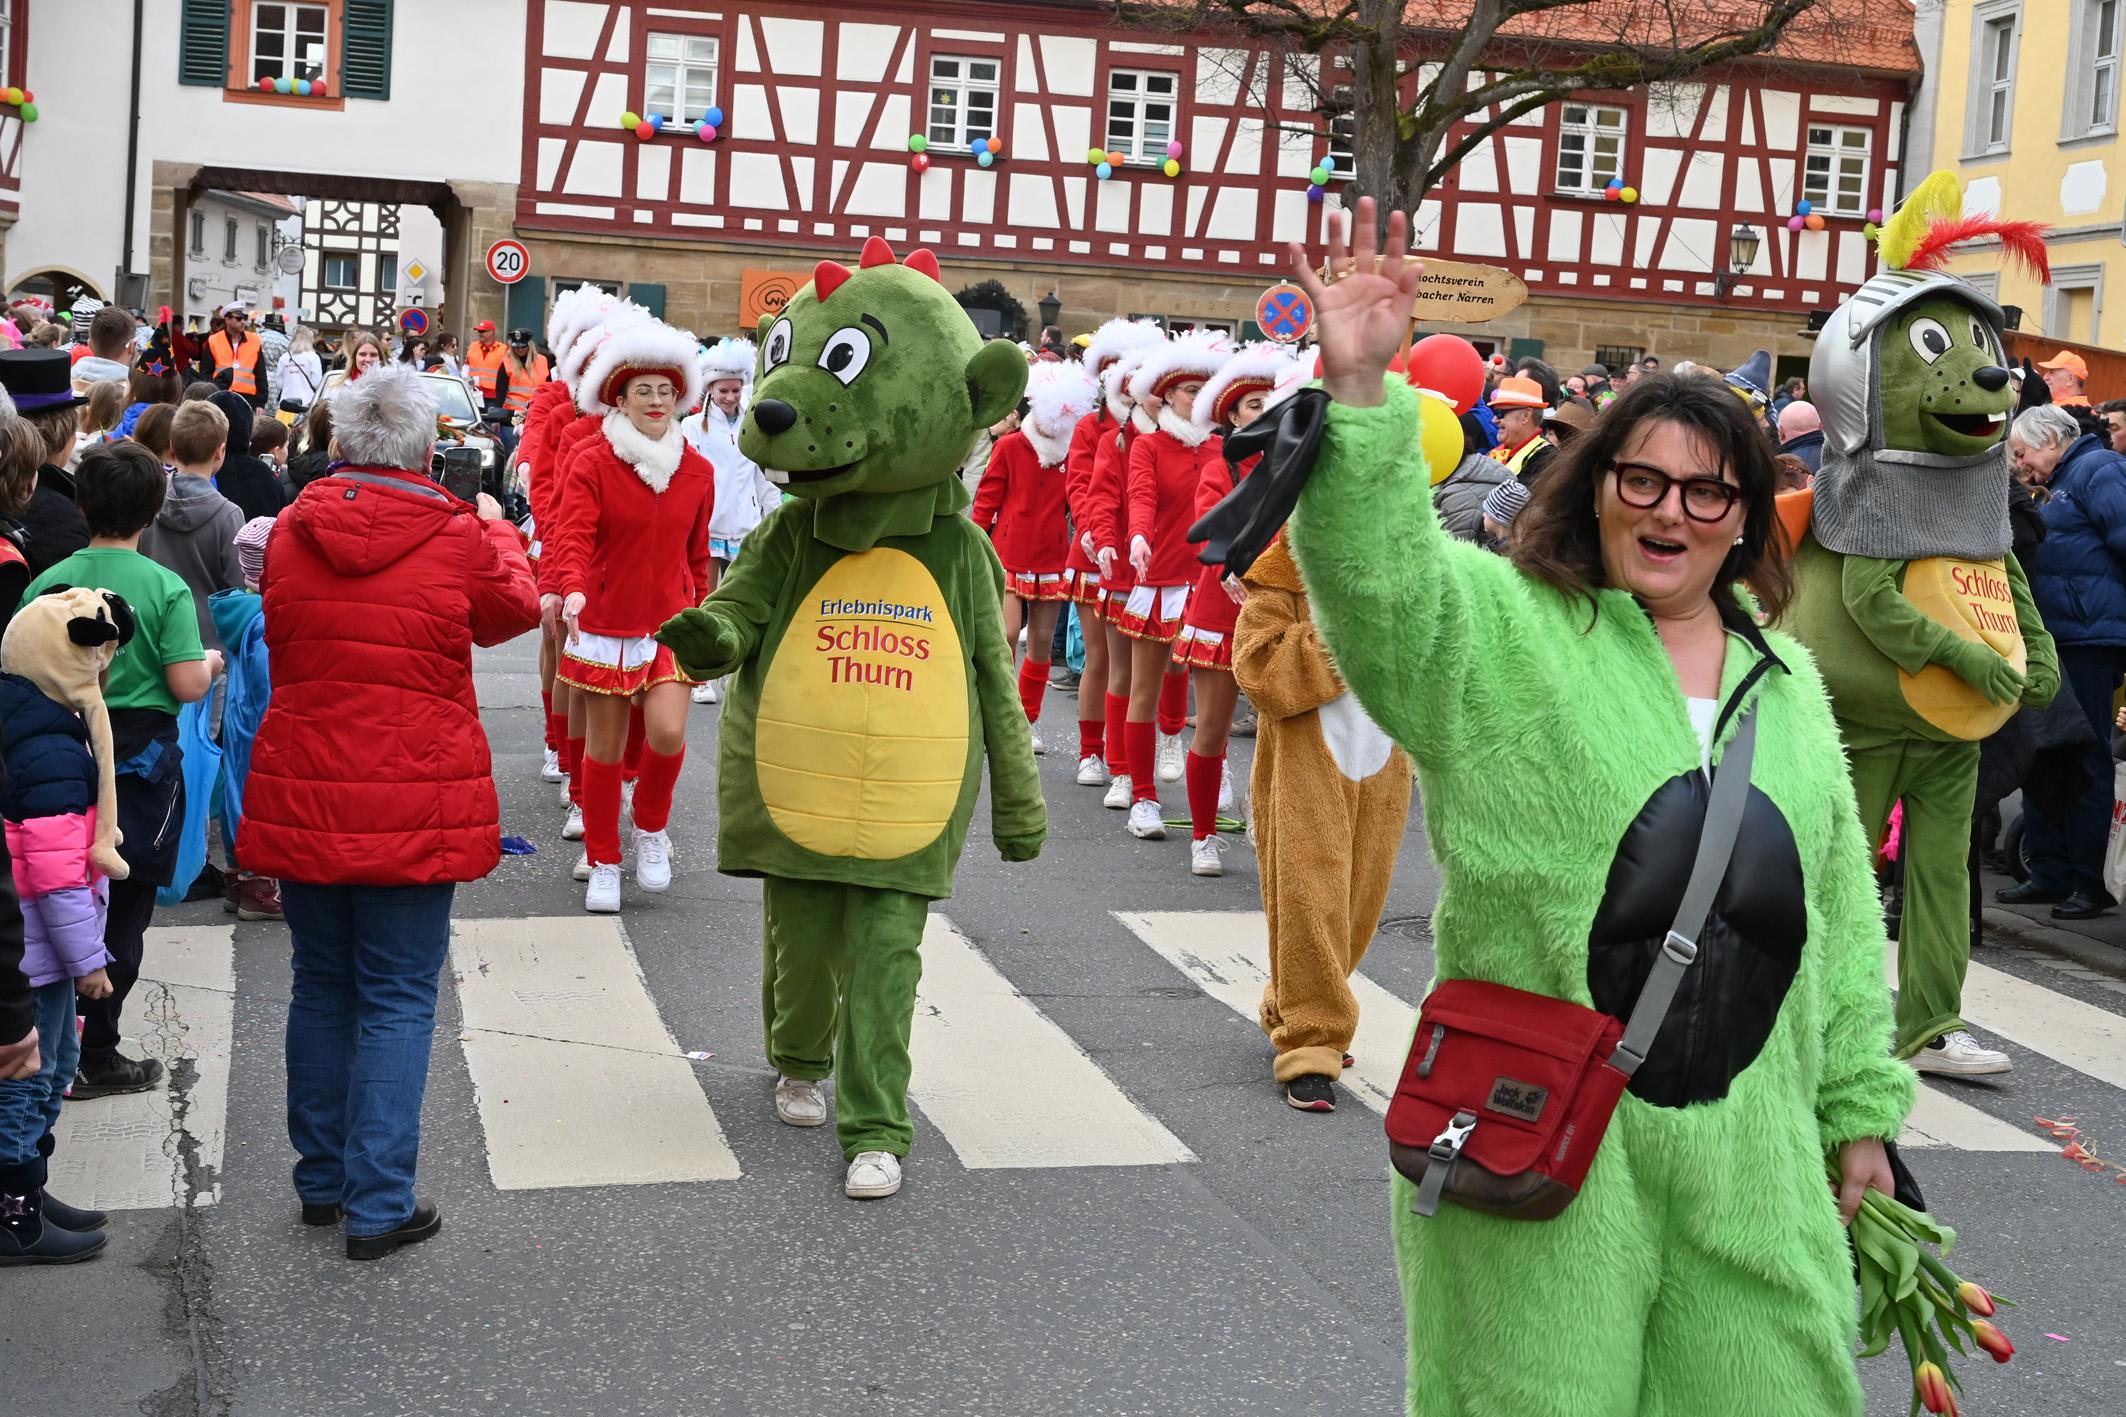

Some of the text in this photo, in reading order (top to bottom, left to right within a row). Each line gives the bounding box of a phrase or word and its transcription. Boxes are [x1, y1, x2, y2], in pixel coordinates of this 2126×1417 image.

[497, 252, 520, 271] 20
[1456, 292, 1494, 304] Narren
[1951, 567, 2012, 603] Schloss
[820, 599, 933, 622] Erlebnispark
[1969, 602, 2017, 634] Thurn
[816, 625, 930, 660] Schloss
[827, 656, 913, 691] Thurn
[1496, 1083, 1521, 1099] Jack
